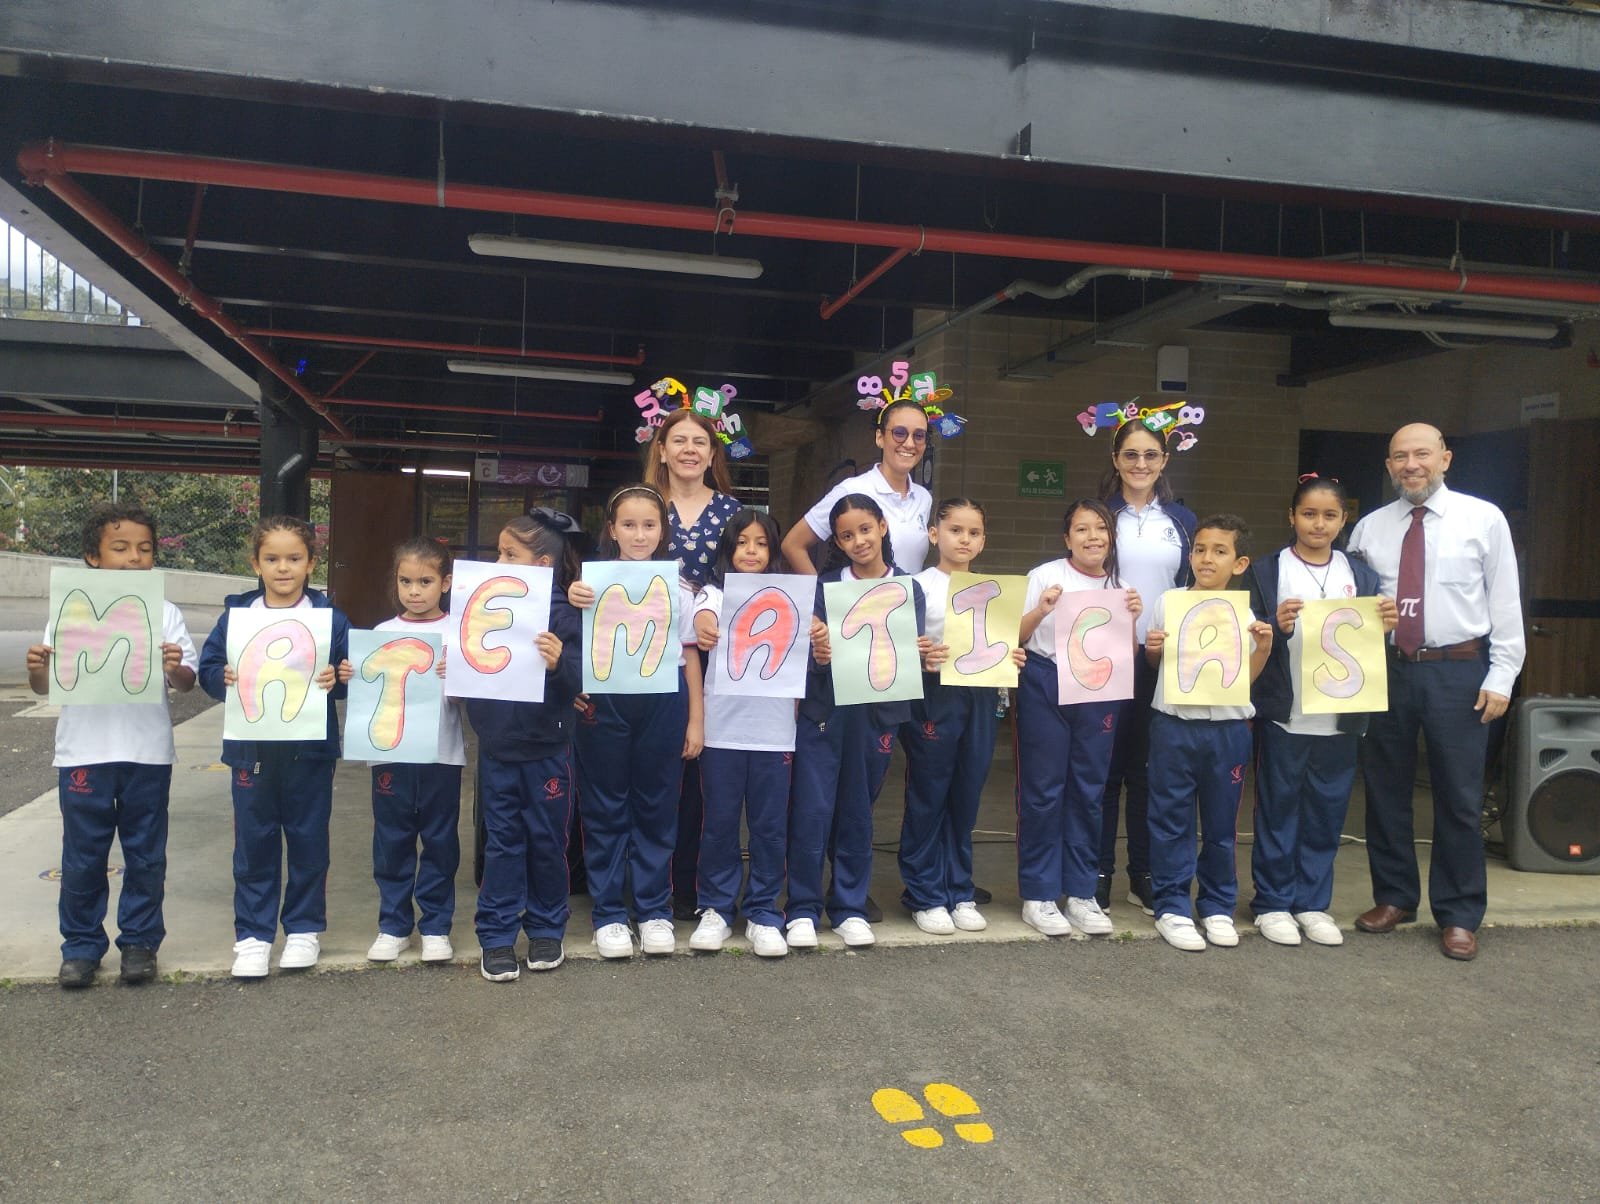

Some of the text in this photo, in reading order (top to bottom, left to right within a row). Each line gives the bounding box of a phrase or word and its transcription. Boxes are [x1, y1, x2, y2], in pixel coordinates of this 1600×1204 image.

[54, 575, 1364, 751] M A T E M A T I C A S
